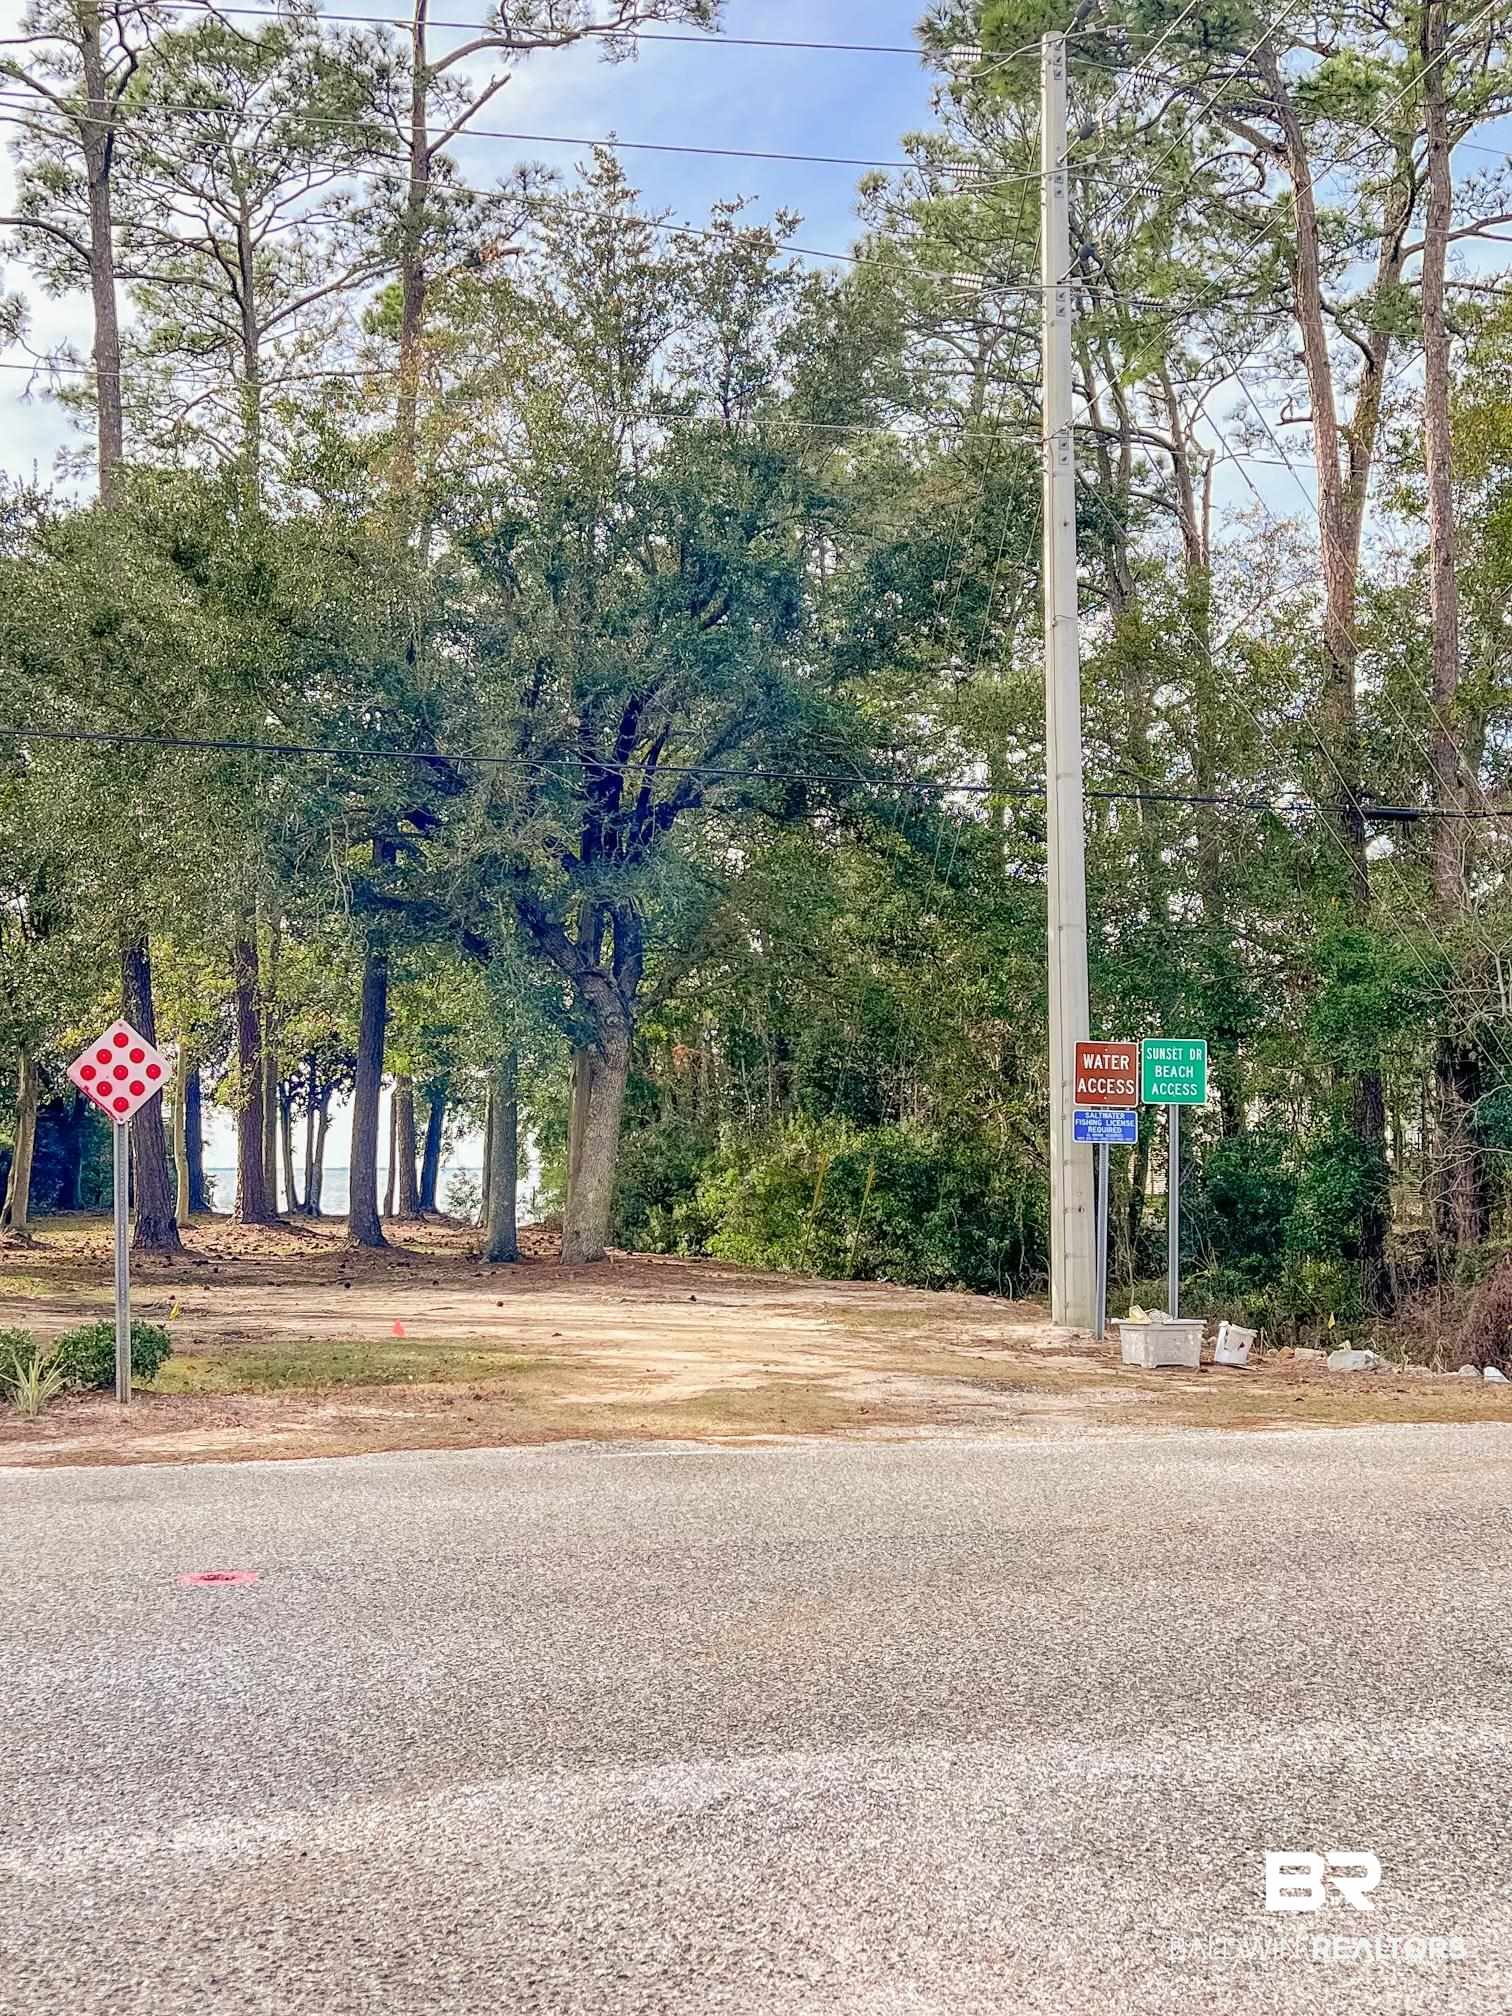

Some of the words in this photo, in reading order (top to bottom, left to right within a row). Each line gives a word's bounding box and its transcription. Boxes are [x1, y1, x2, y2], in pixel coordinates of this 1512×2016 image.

[1146, 1047, 1184, 1061] SUNSET
[1190, 1048, 1202, 1061] DR
[1083, 1053, 1130, 1070] WATER
[1154, 1065, 1194, 1078] BEACH
[1078, 1077, 1135, 1095] ACCESS
[1151, 1082, 1198, 1096] ACCESS
[1085, 1112, 1126, 1120] SALTWATER
[1105, 1119, 1135, 1127] LICENSE
[1087, 1126, 1122, 1134] REQUIRED
